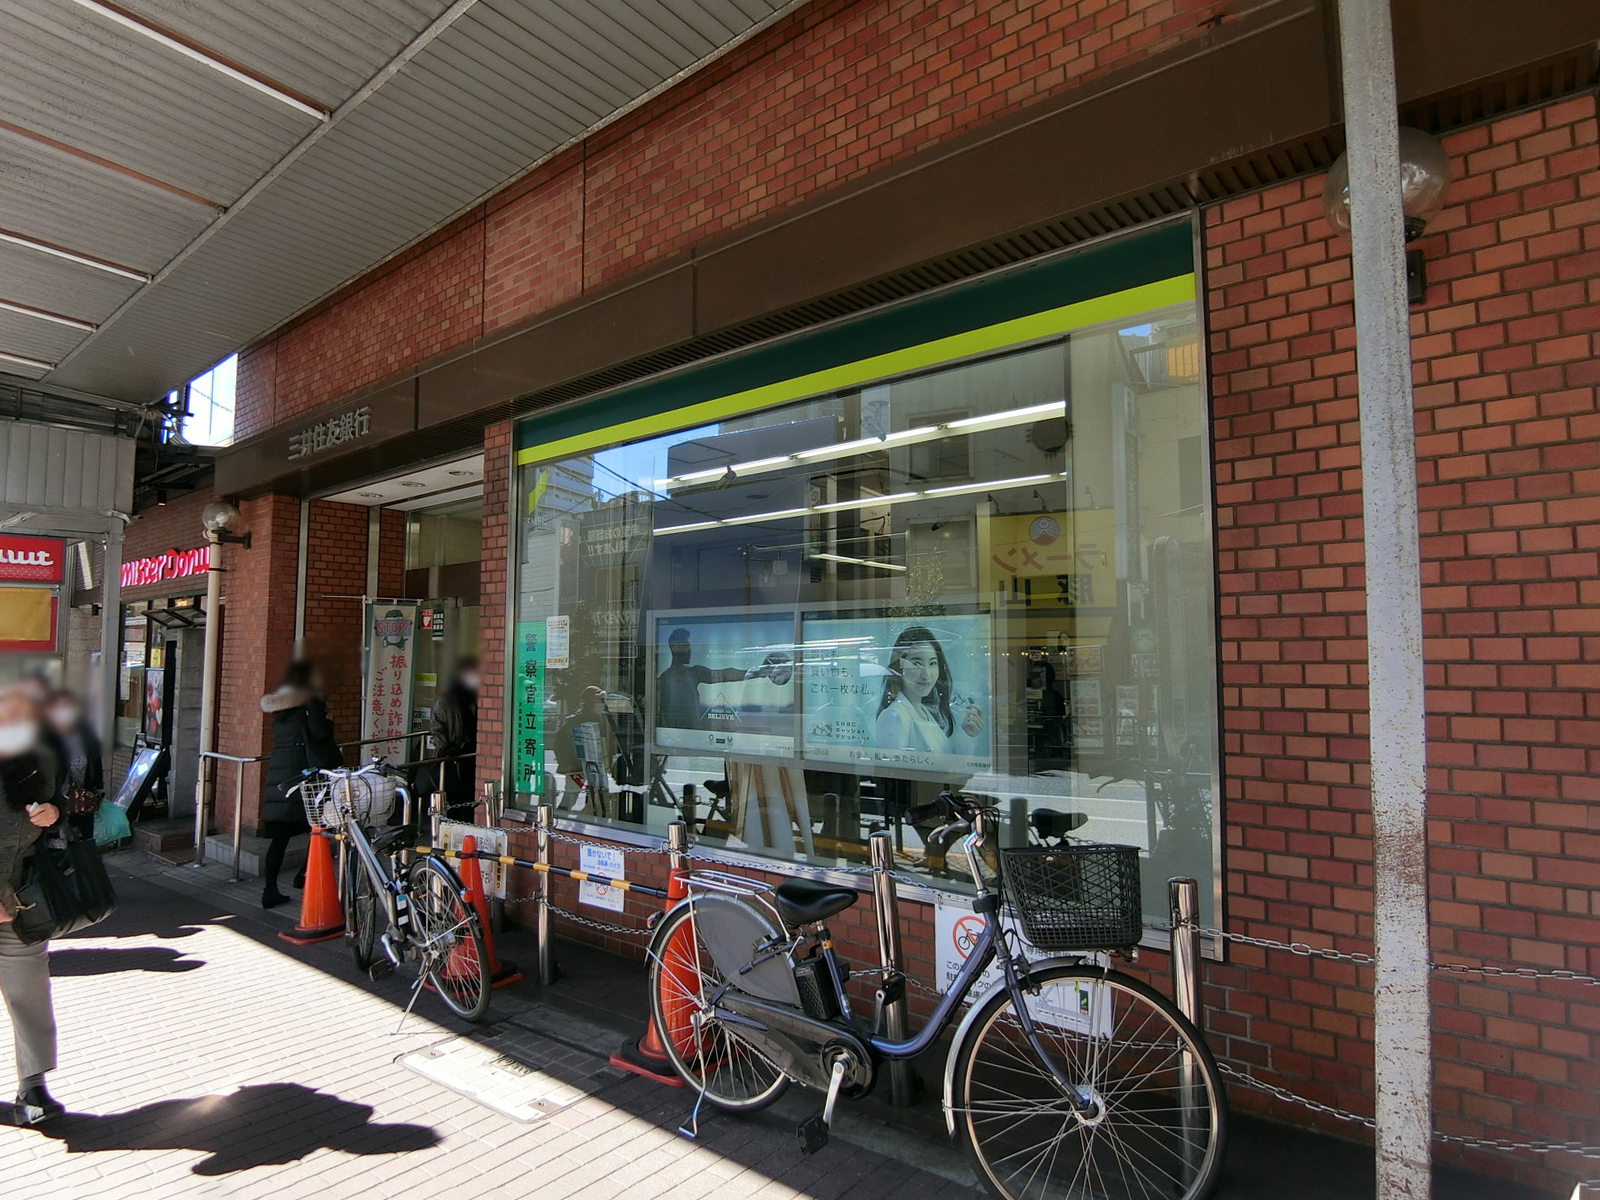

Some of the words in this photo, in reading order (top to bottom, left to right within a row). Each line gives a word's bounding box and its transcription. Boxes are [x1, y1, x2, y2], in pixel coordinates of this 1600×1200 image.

[288, 406, 371, 460] 三井住友銀行
[165, 546, 211, 580] Donu
[377, 621, 411, 634] STOP!
[386, 654, 408, 755] 振り込め詐欺に
[811, 683, 875, 696] これ一枚な私。
[370, 666, 388, 757] ご注意くださ
[523, 632, 538, 782] 警察官立寄所
[707, 713, 735, 721] BELIEVE
[835, 720, 857, 728] SMBC
